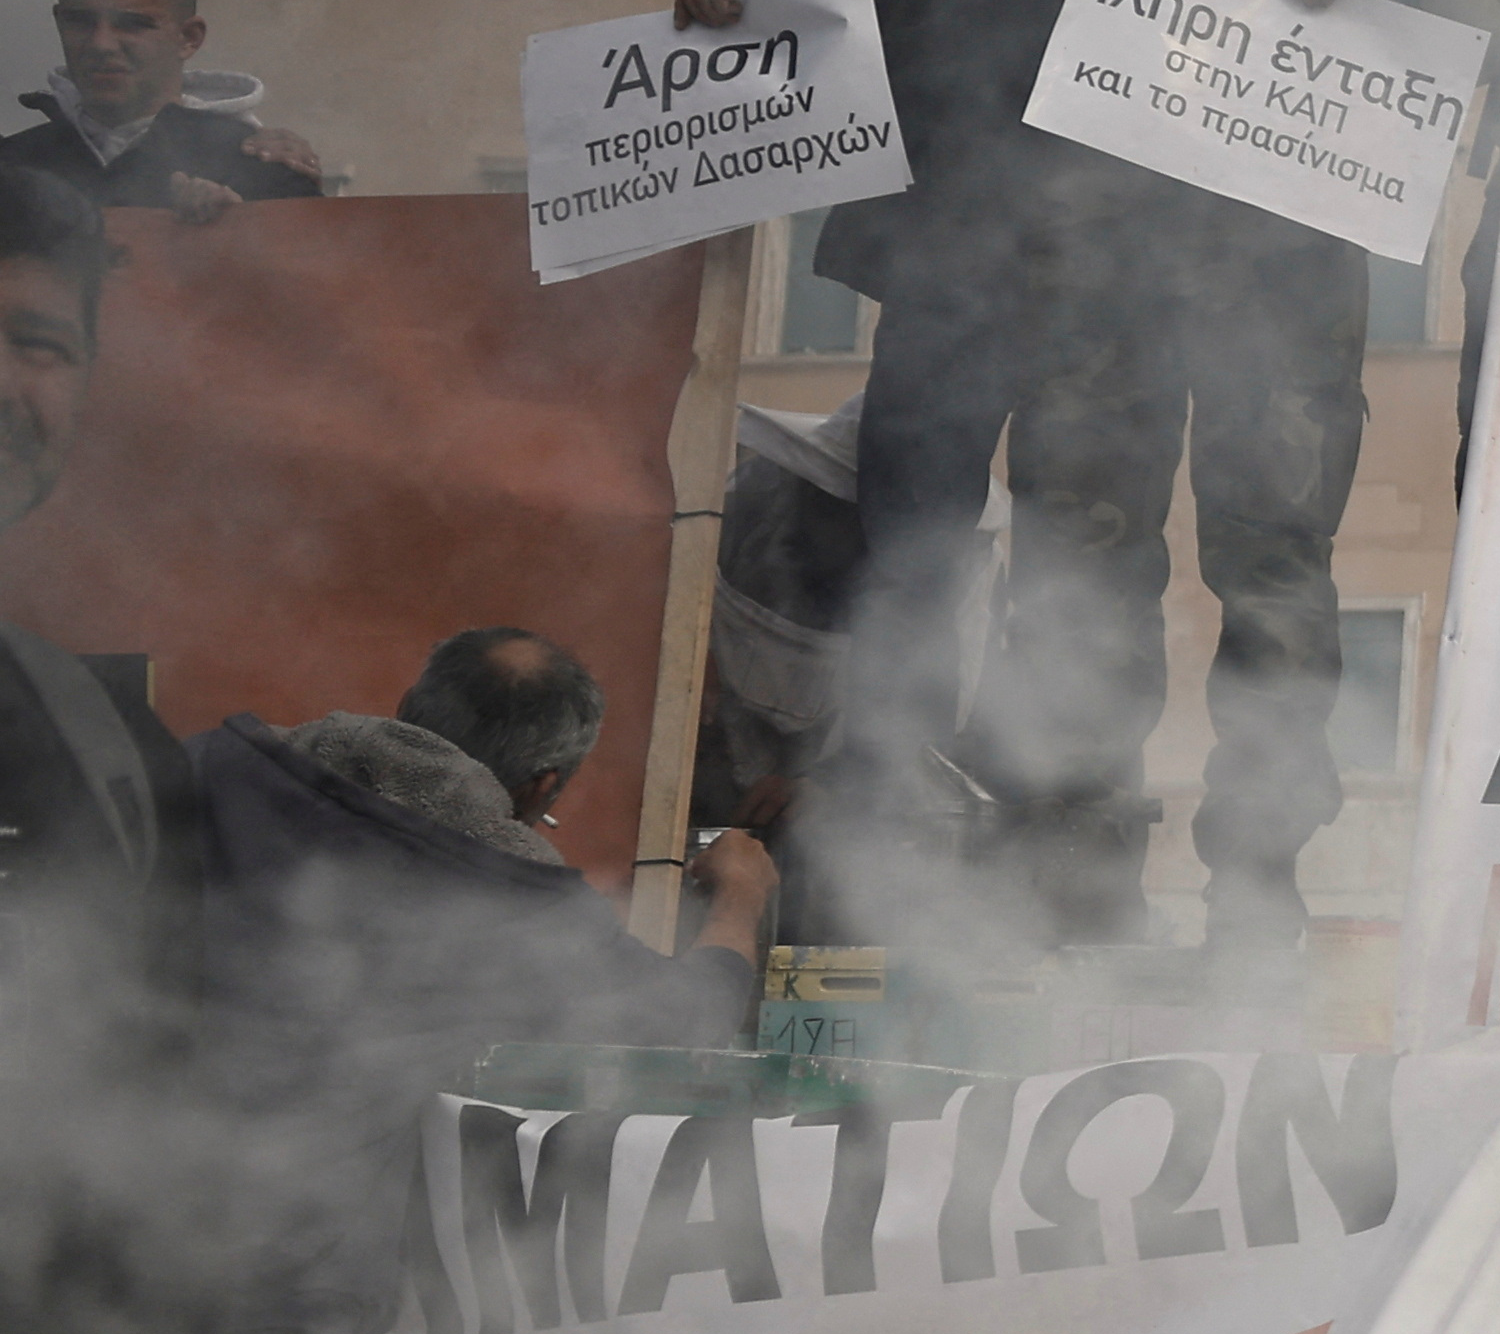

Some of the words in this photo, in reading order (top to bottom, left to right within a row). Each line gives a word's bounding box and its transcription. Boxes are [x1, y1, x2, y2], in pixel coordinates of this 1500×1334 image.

[600, 29, 801, 114] Άρση
[1162, 44, 1258, 103] στην
[1261, 75, 1349, 136] ΚΑΠ
[1271, 20, 1466, 143] ένταξη
[530, 161, 680, 229] τοπικών
[693, 112, 893, 192] Δασαρχών
[585, 81, 816, 169] περιορισμών
[1071, 57, 1134, 103] και
[1146, 81, 1188, 120] το
[1198, 98, 1407, 207] πρασίνισμα
